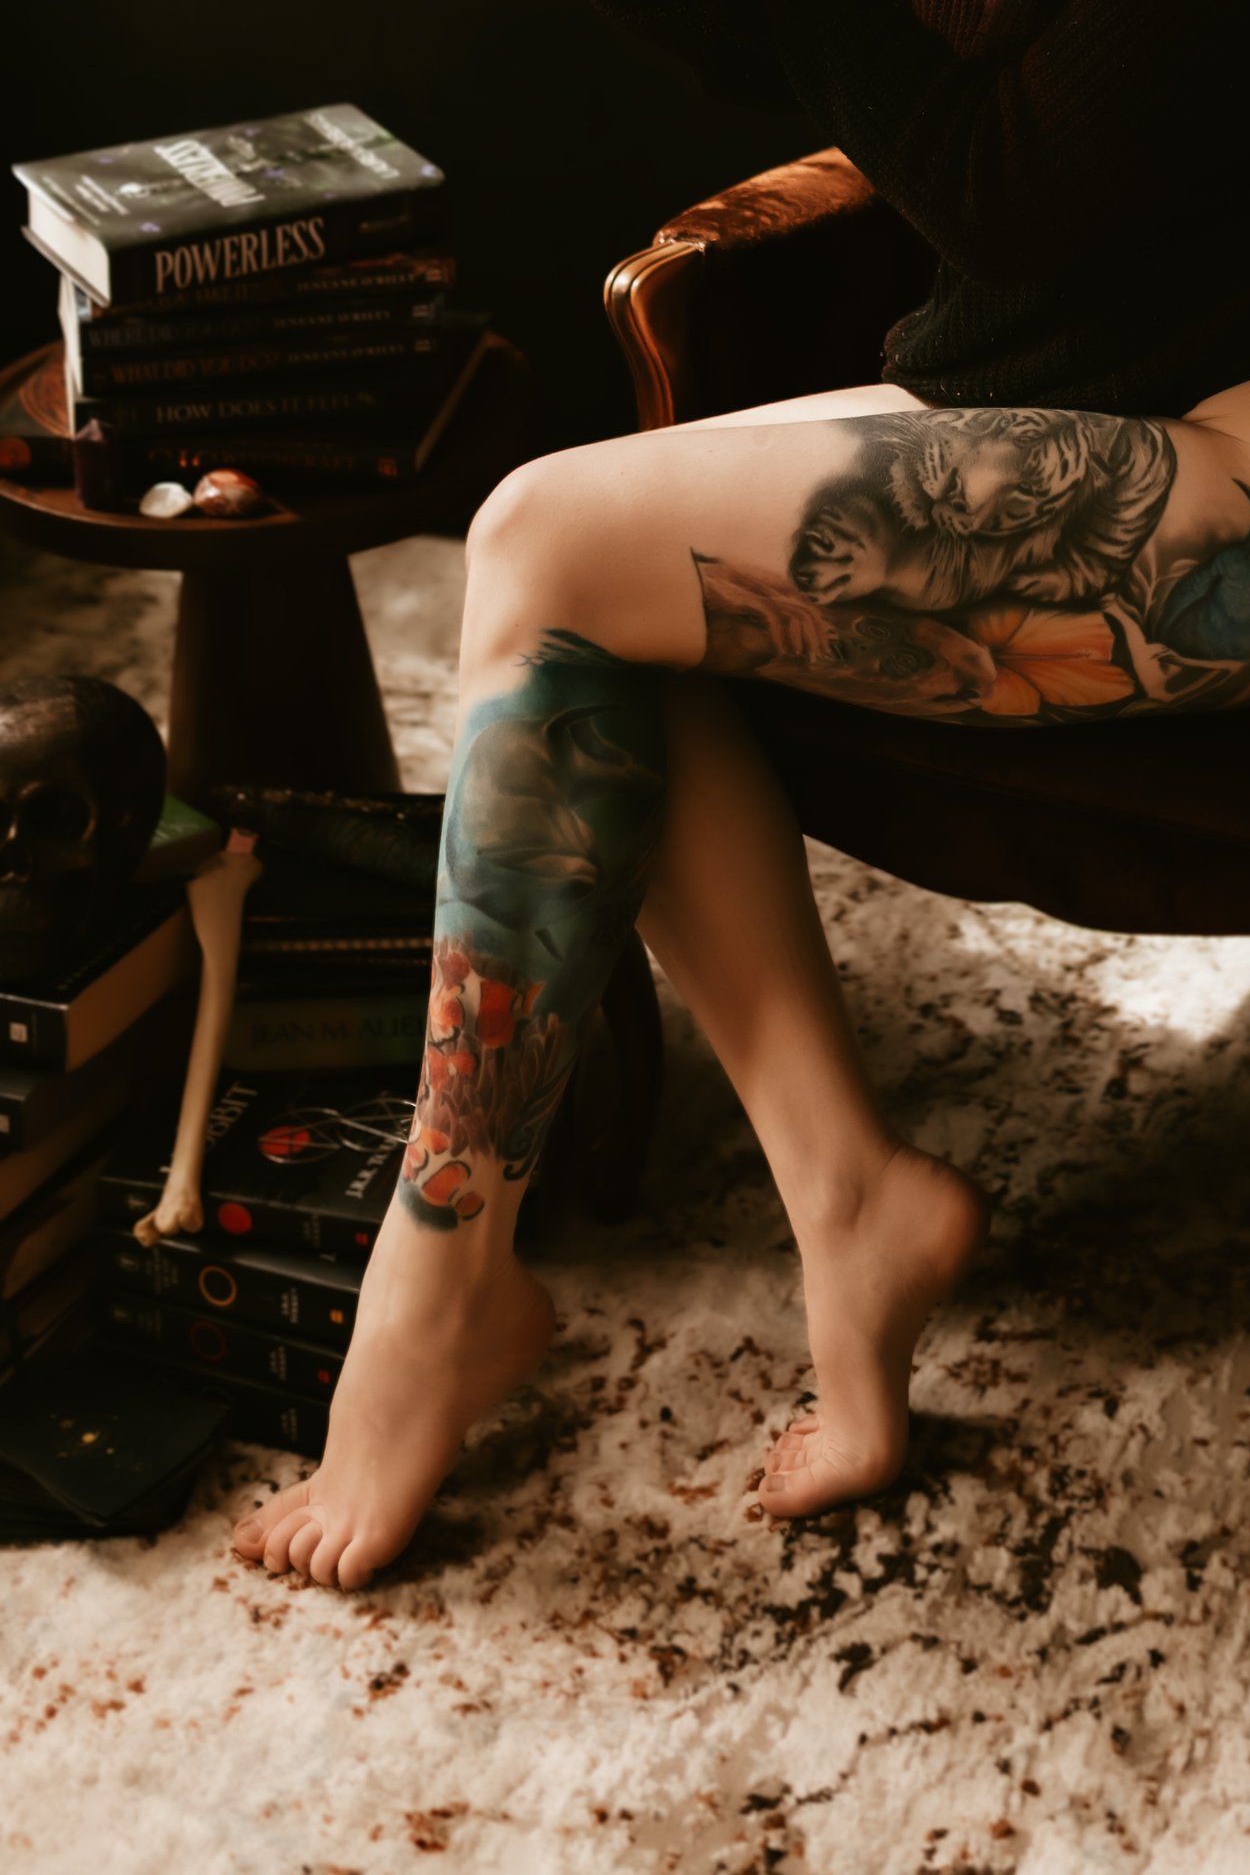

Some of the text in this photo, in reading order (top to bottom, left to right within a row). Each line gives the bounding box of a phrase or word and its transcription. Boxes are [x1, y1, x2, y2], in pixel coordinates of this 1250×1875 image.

[154, 215, 327, 294] POWERLESS
[156, 403, 213, 425] HOW
[217, 399, 277, 421] DOES
